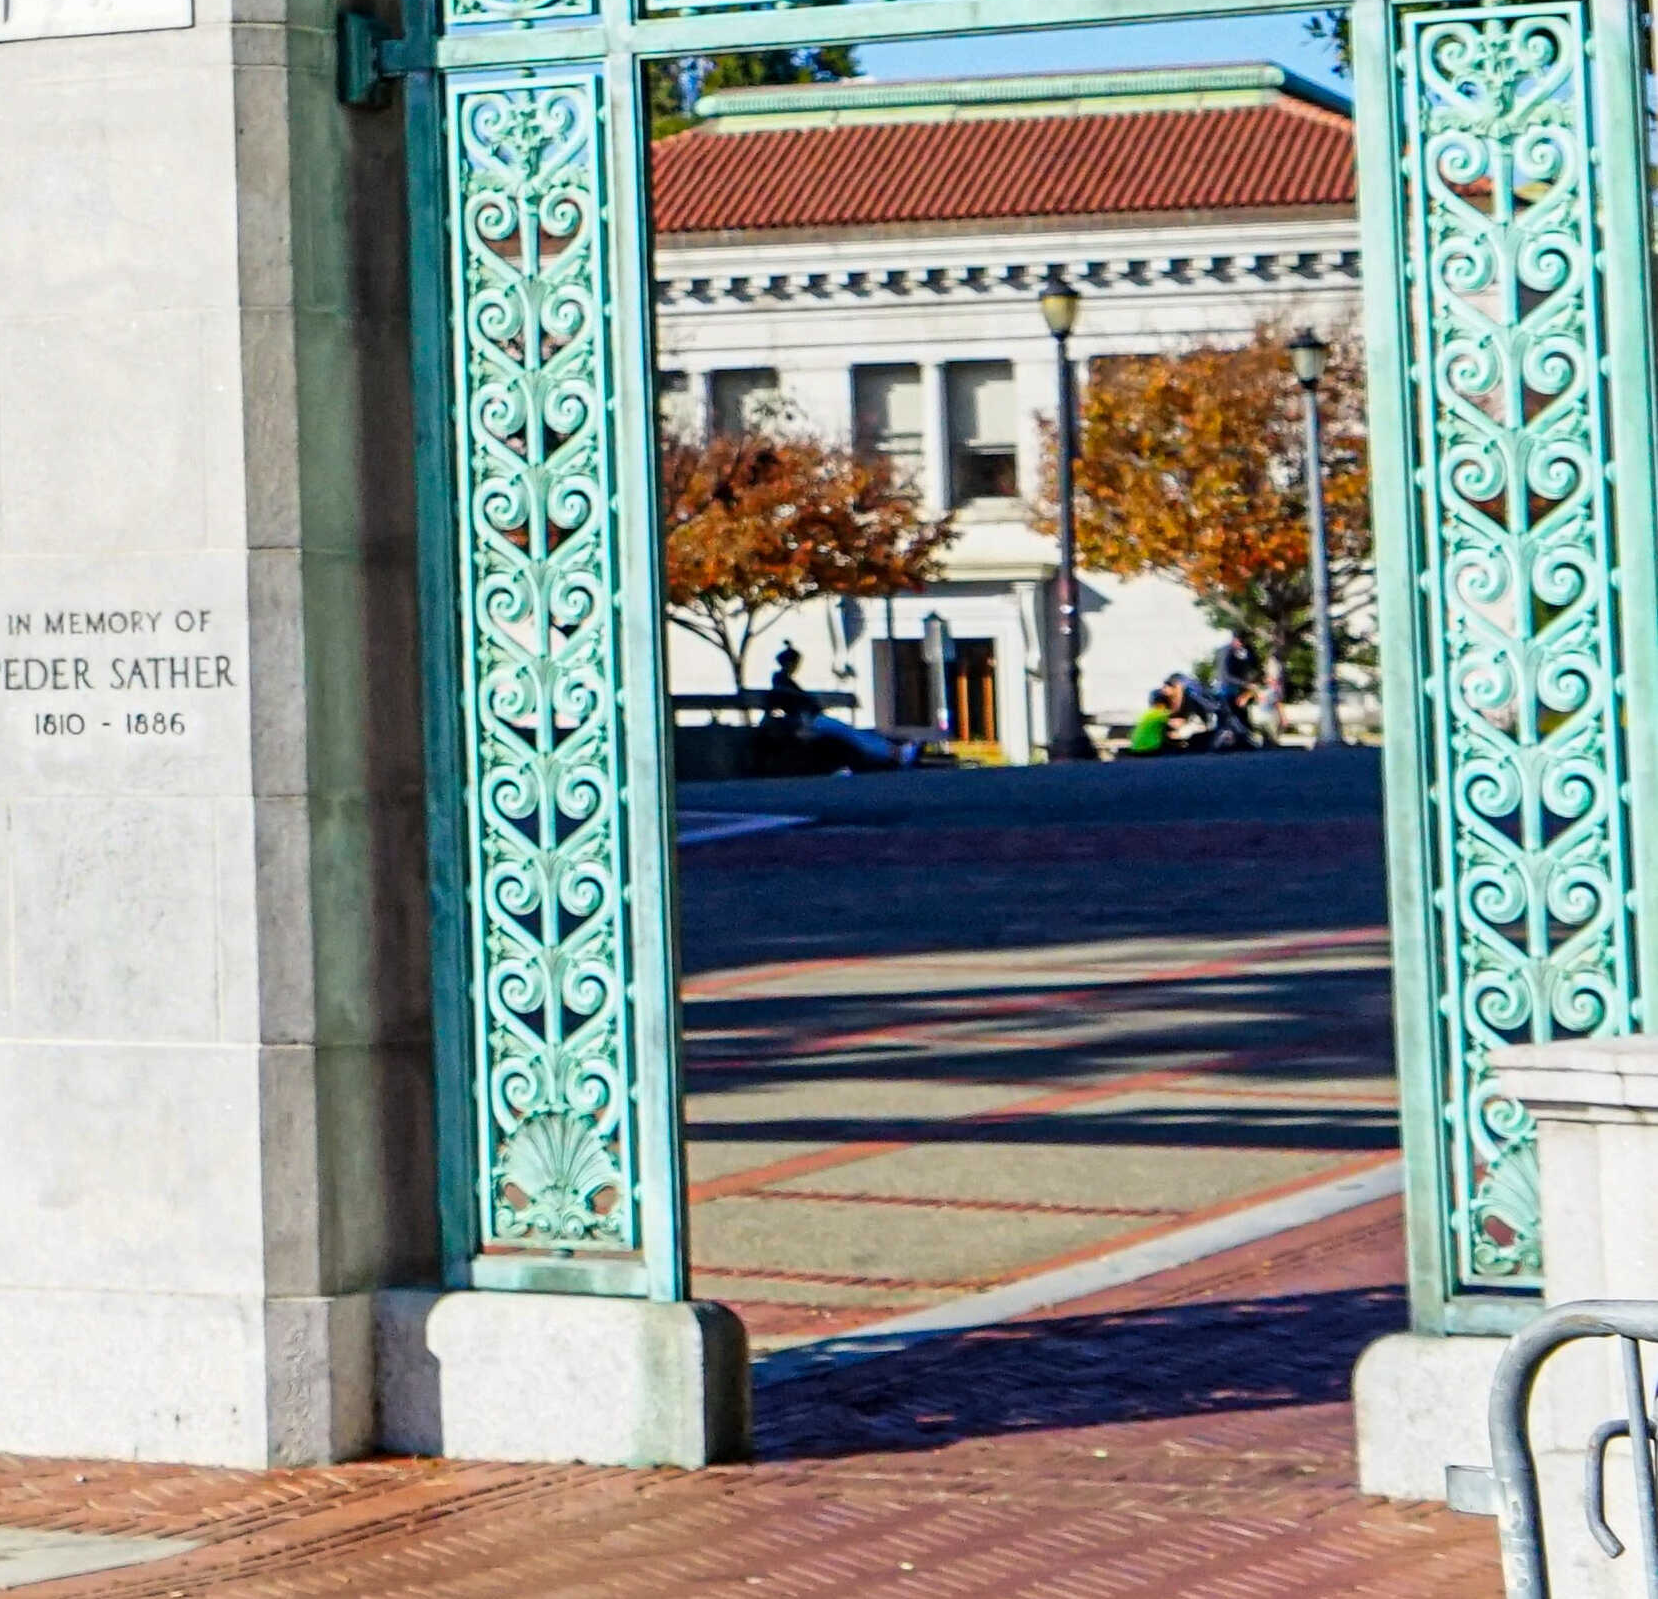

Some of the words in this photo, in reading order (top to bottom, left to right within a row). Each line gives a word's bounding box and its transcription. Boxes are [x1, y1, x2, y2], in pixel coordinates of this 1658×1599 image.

[7, 613, 31, 636] IN
[45, 610, 162, 635] MEMORY
[175, 609, 213, 633] OF
[109, 655, 238, 690] SATHER
[35, 712, 86, 736] 1810
[126, 712, 186, 735] 1886
